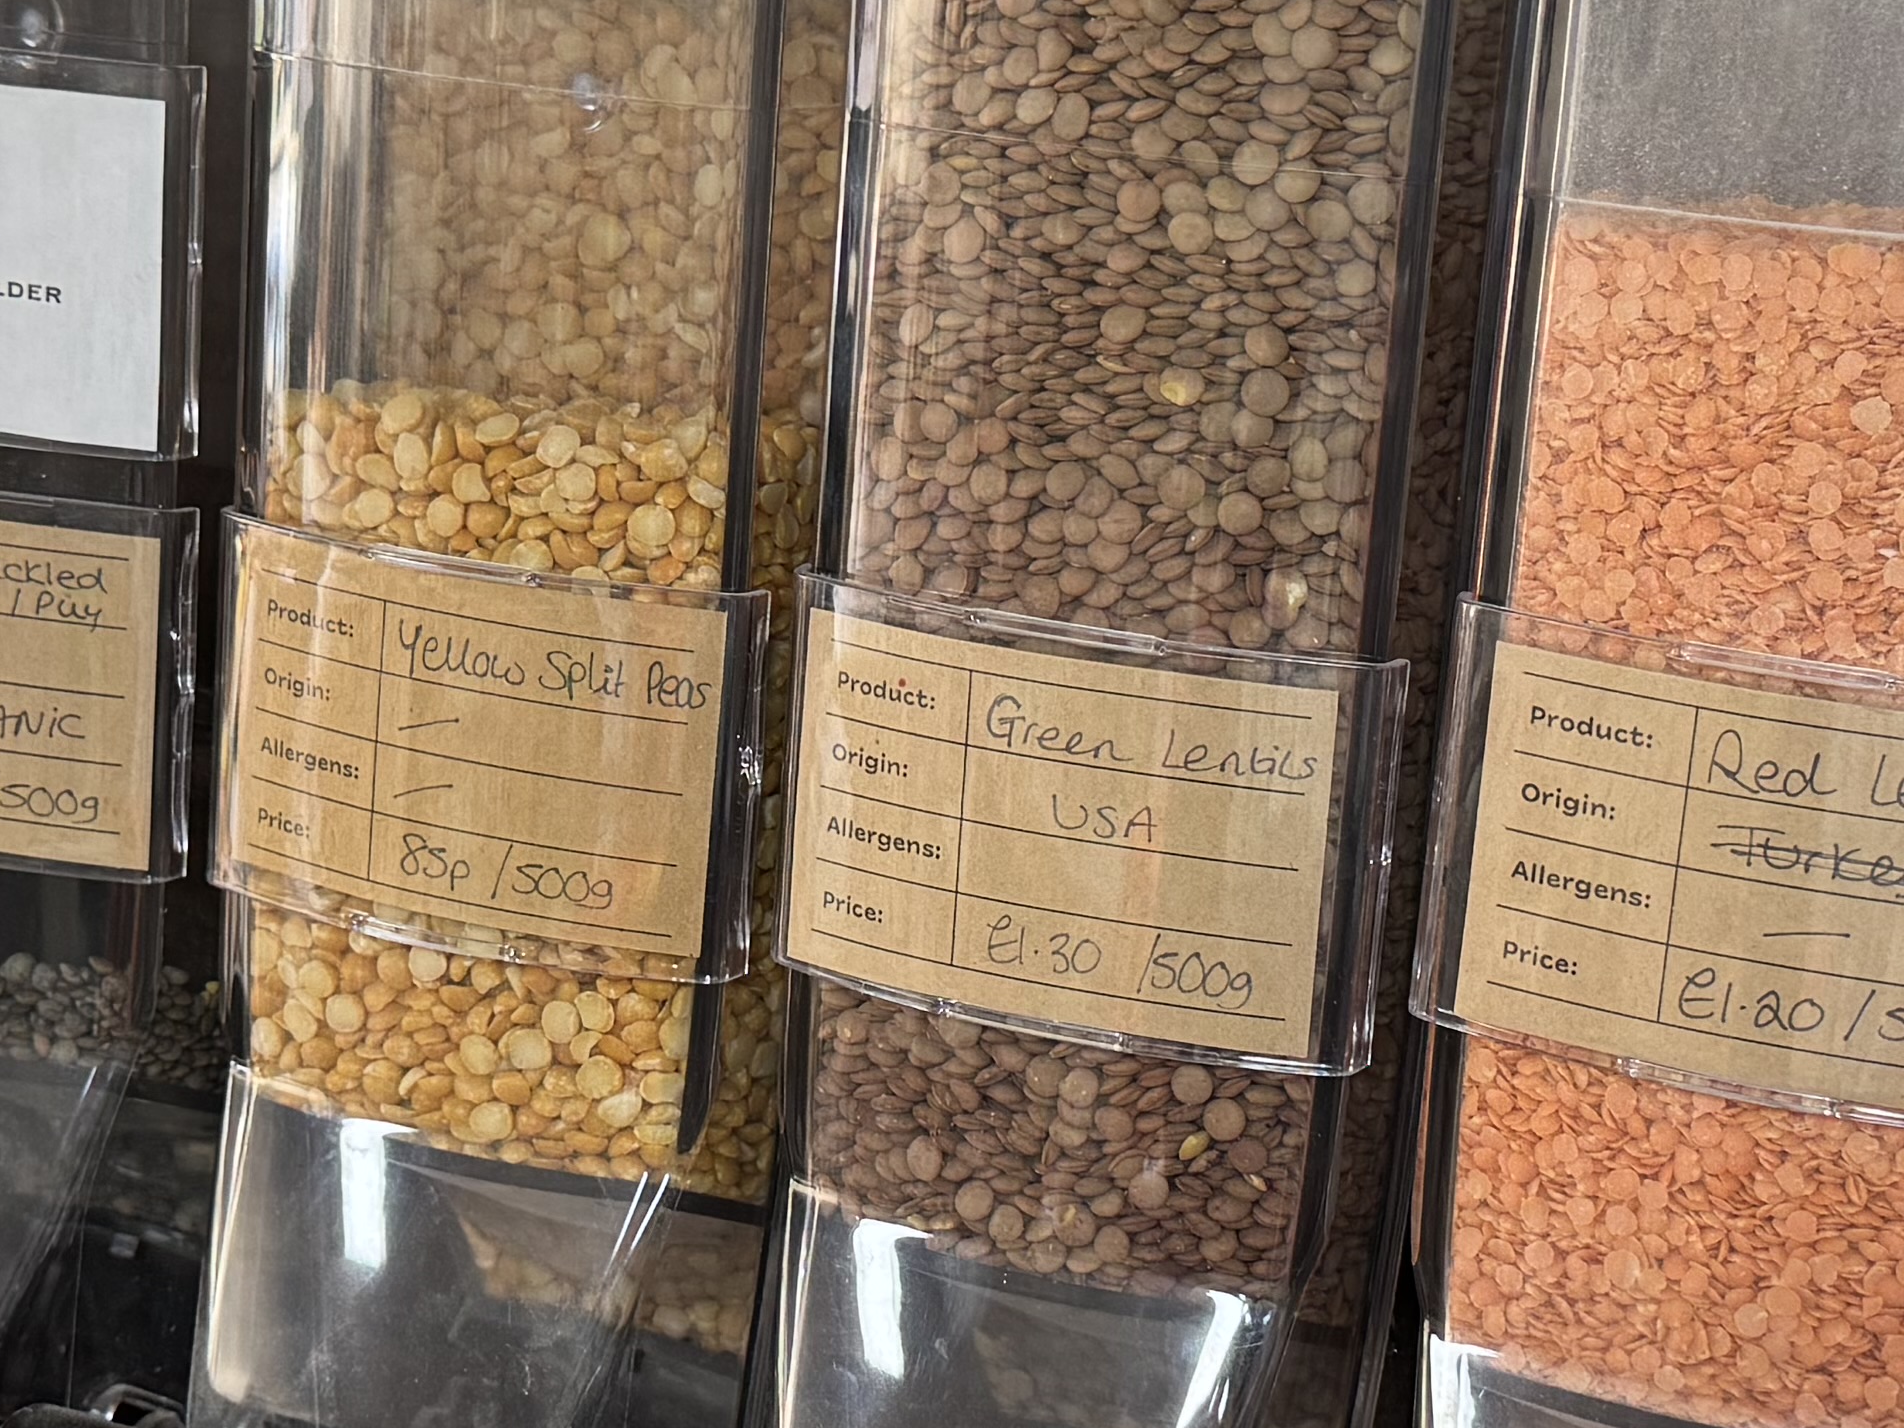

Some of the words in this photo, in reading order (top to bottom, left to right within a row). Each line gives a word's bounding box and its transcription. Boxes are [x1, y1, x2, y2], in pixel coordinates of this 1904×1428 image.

[263, 667, 331, 702] Origin:
[267, 598, 355, 638] Product:
[399, 618, 525, 686] Yellow
[538, 650, 626, 700] Split
[647, 661, 714, 710] Peas
[260, 737, 360, 780] Allergens:
[837, 672, 936, 711] Product:
[985, 693, 1134, 763] Green
[1161, 729, 1319, 781] Lentils
[1529, 705, 1654, 750] Product:
[1707, 729, 1838, 797] Red
[832, 743, 909, 778] Origin:
[1051, 793, 1158, 844] USA
[1521, 783, 1616, 821] Origin:
[257, 808, 311, 840] Price:
[399, 833, 470, 891] 85p
[826, 815, 942, 861] Allergens:
[1510, 859, 1652, 910] Allergens:
[823, 891, 884, 924] Price:
[986, 915, 1102, 975] £1.30
[1502, 939, 1578, 976] Price:
[1677, 966, 1825, 1033] £1.20
